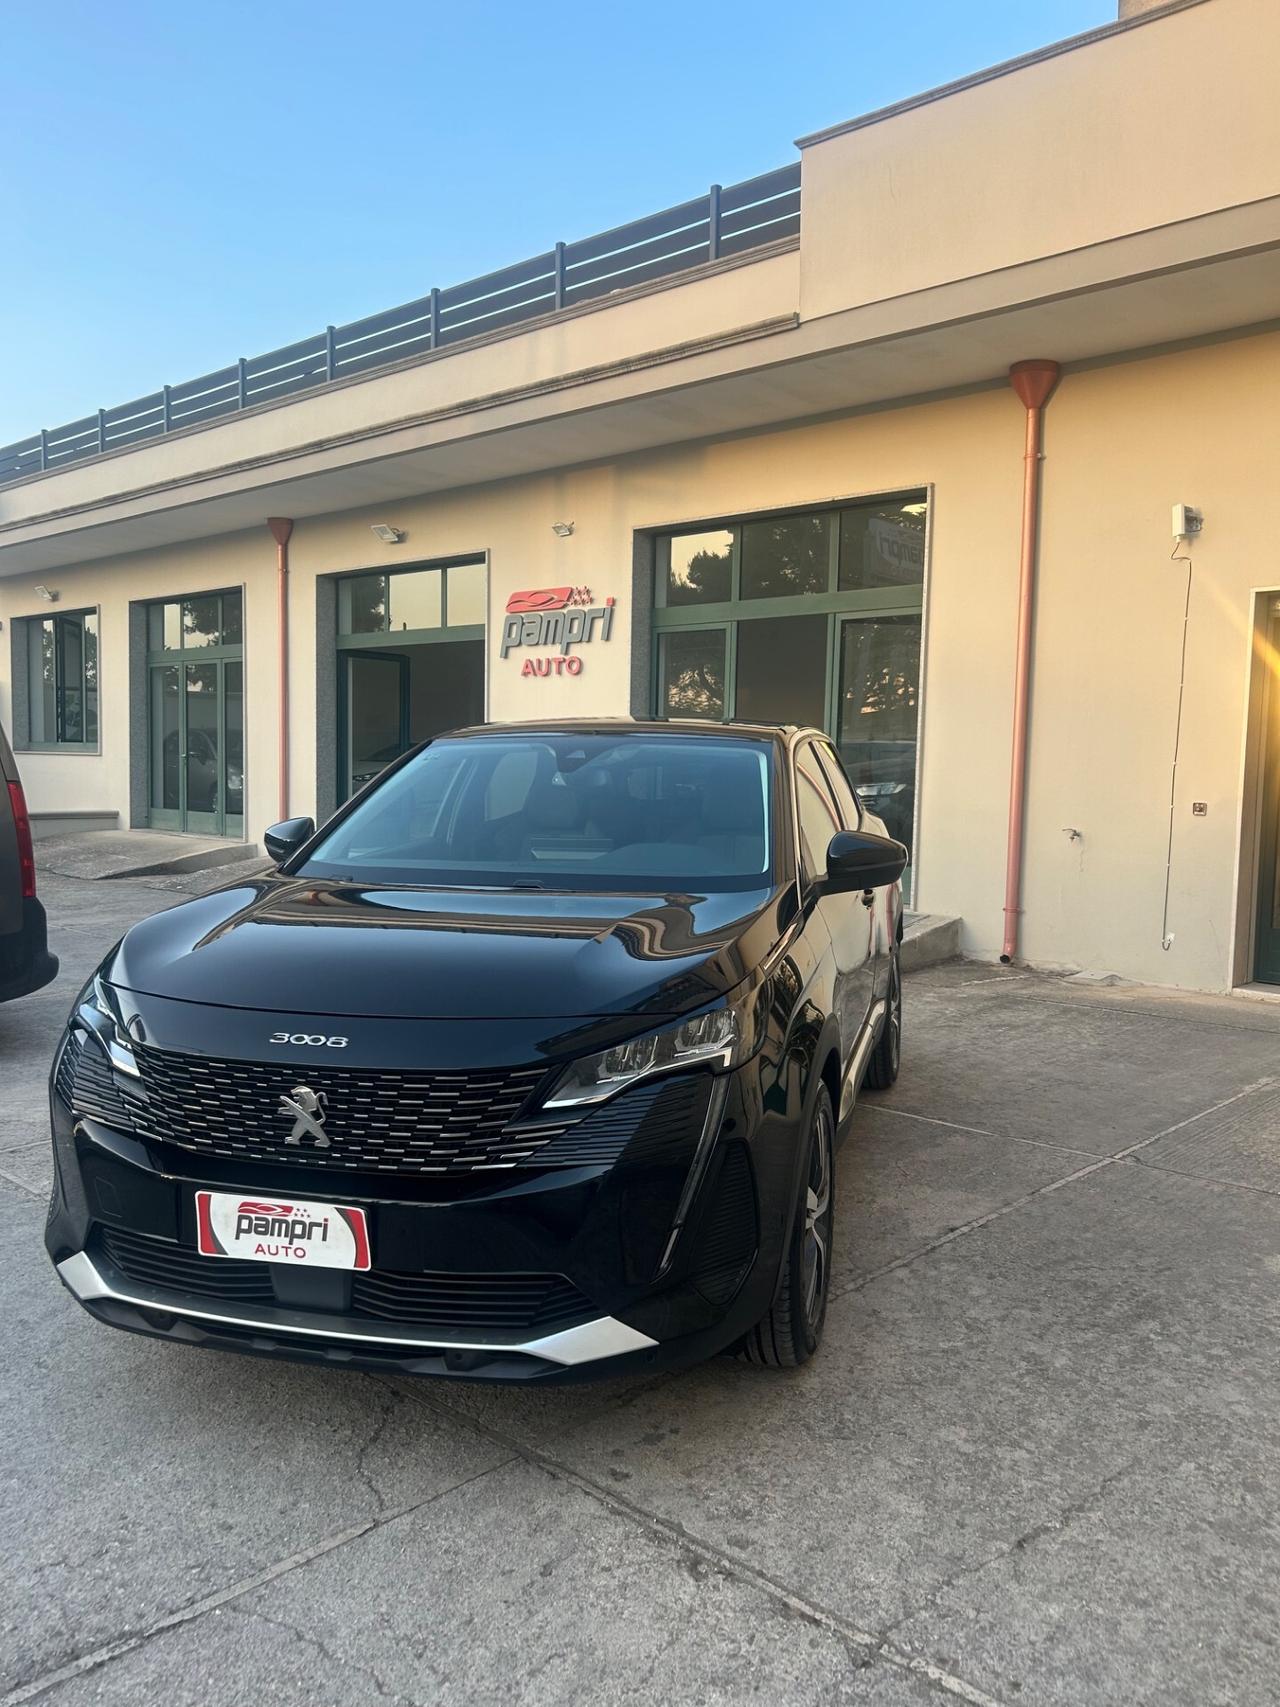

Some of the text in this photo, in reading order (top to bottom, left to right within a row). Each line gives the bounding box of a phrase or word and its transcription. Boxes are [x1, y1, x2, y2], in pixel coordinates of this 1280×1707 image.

[500, 597, 615, 659] pampri
[521, 656, 583, 677] AUTO
[269, 1032, 349, 1048] 3008
[234, 1214, 329, 1246] pampri
[254, 1243, 307, 1259] AUTO
